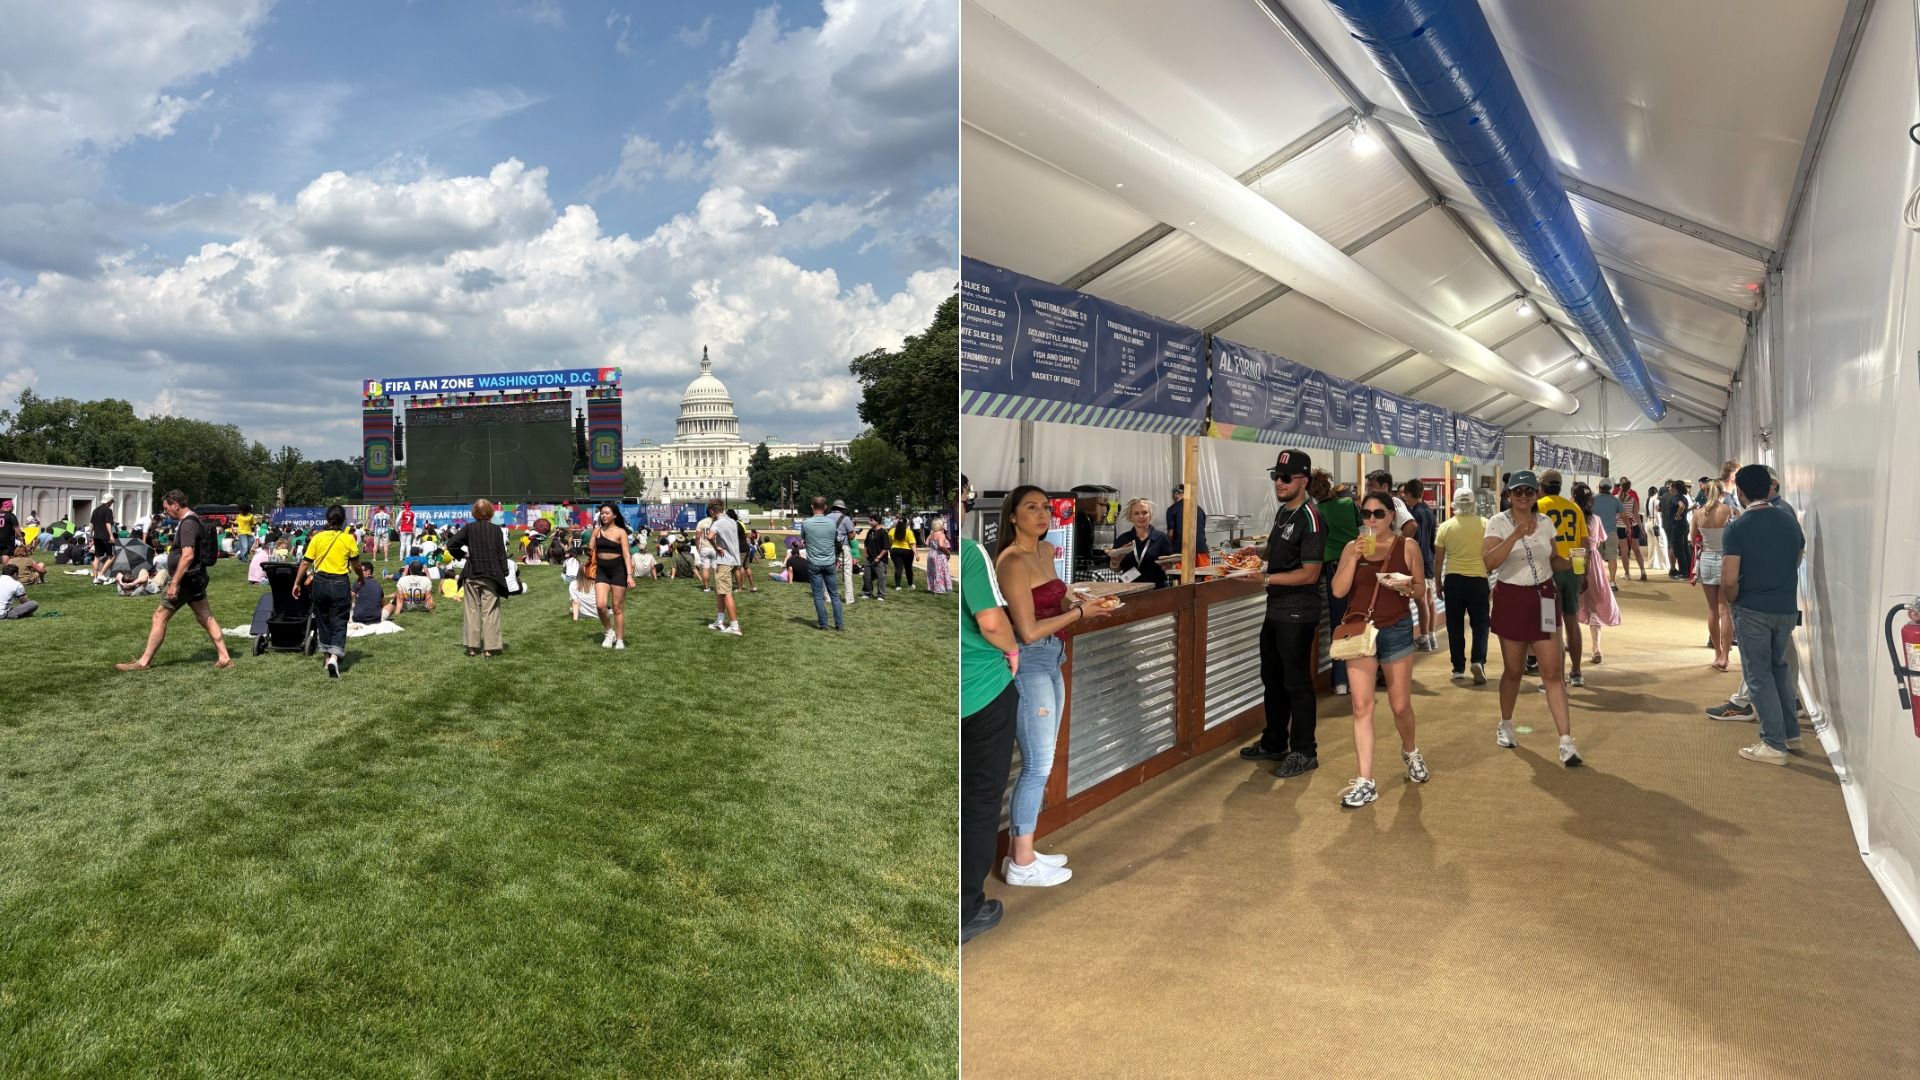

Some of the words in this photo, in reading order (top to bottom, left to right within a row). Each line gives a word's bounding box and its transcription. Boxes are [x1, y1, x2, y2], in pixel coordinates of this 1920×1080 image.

[963, 280, 981, 291] SLICE
[962, 301, 980, 312] PIZZA
[981, 306, 998, 317] SLICE
[973, 329, 990, 340] SLICE
[1046, 353, 1058, 361] AND
[1219, 351, 1234, 372] AL
[1233, 355, 1262, 380] FORNO
[1031, 371, 1053, 381] BASKET
[385, 381, 411, 392] FIFA
[414, 379, 438, 391] FAN
[441, 378, 474, 389] ZONE
[479, 373, 567, 388] WASHINGTON,
[570, 372, 595, 383] D.C.
[405, 515, 411, 524] 7
[415, 511, 431, 519] FIFA
[433, 511, 450, 519] FAN
[1546, 508, 1577, 541] 23
[573, 540, 582, 548] 17
[408, 587, 422, 605] 10
